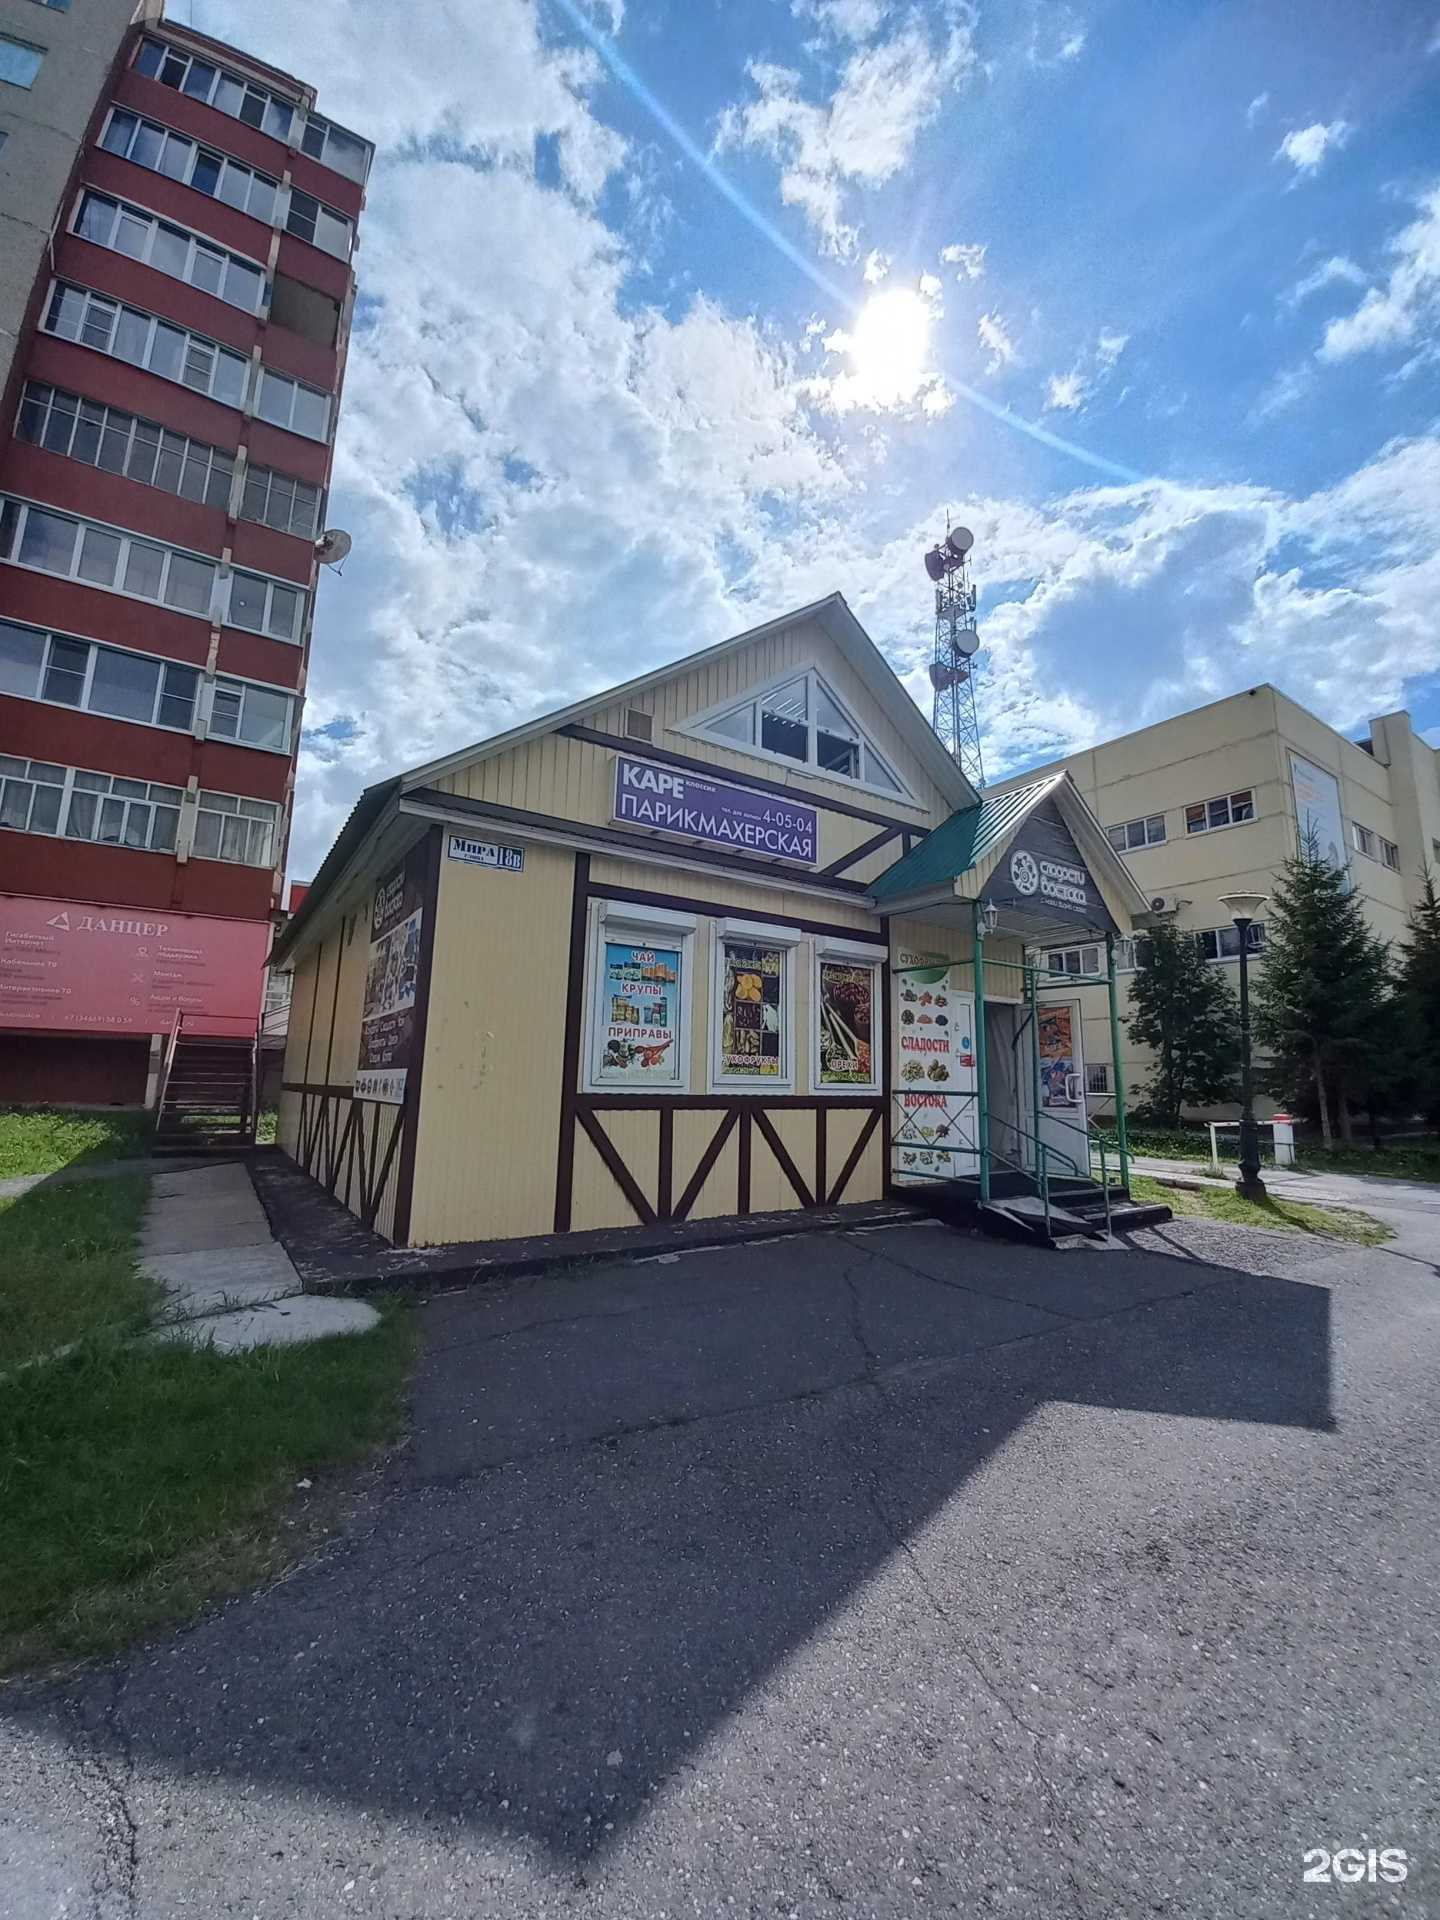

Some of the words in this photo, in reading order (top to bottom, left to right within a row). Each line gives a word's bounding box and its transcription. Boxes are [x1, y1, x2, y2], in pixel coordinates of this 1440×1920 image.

[623, 763, 685, 800] КАРЕ
[621, 793, 813, 858] ПАРИКМАХЕРСКАЯ
[762, 808, 812, 835] 4-05-04
[76, 915, 170, 938] ДАНЦЕР
[632, 950, 656, 963] ЧАЙ
[622, 983, 662, 996] КРУПЫ
[608, 1026, 673, 1040] ПРИПРАВЫ
[901, 1035, 949, 1053] СЛАДОСТИ
